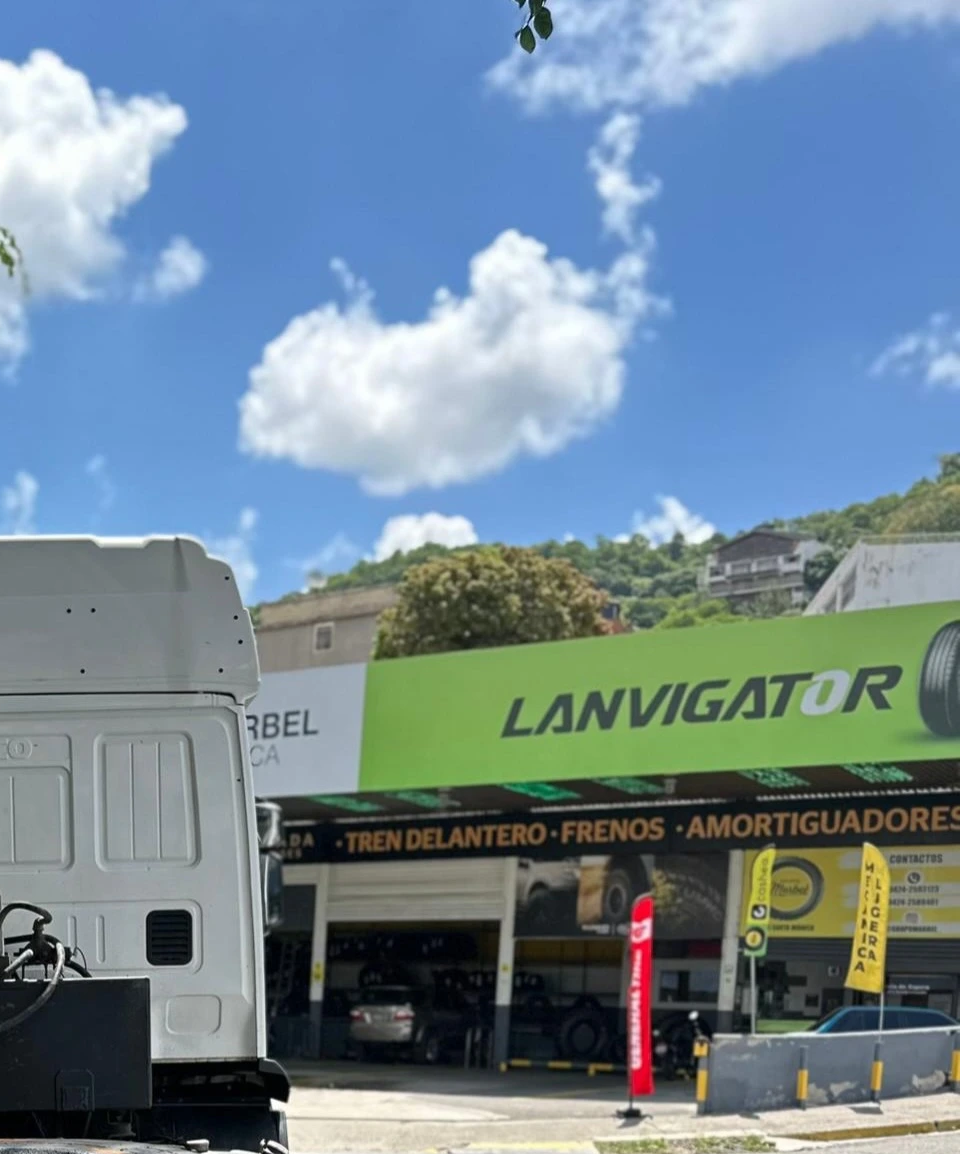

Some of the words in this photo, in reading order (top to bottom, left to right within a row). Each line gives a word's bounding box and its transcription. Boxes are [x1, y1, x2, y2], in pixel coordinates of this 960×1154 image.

[501, 665, 903, 738] LANVIGATOR
[345, 829, 402, 853] TREN
[405, 823, 547, 851] DELANTERO
[560, 817, 665, 843] FRENOS
[686, 805, 960, 840] AMORTIGUADORES
[890, 854, 944, 864] CONTACTOS
[867, 878, 882, 962] LIGERA
